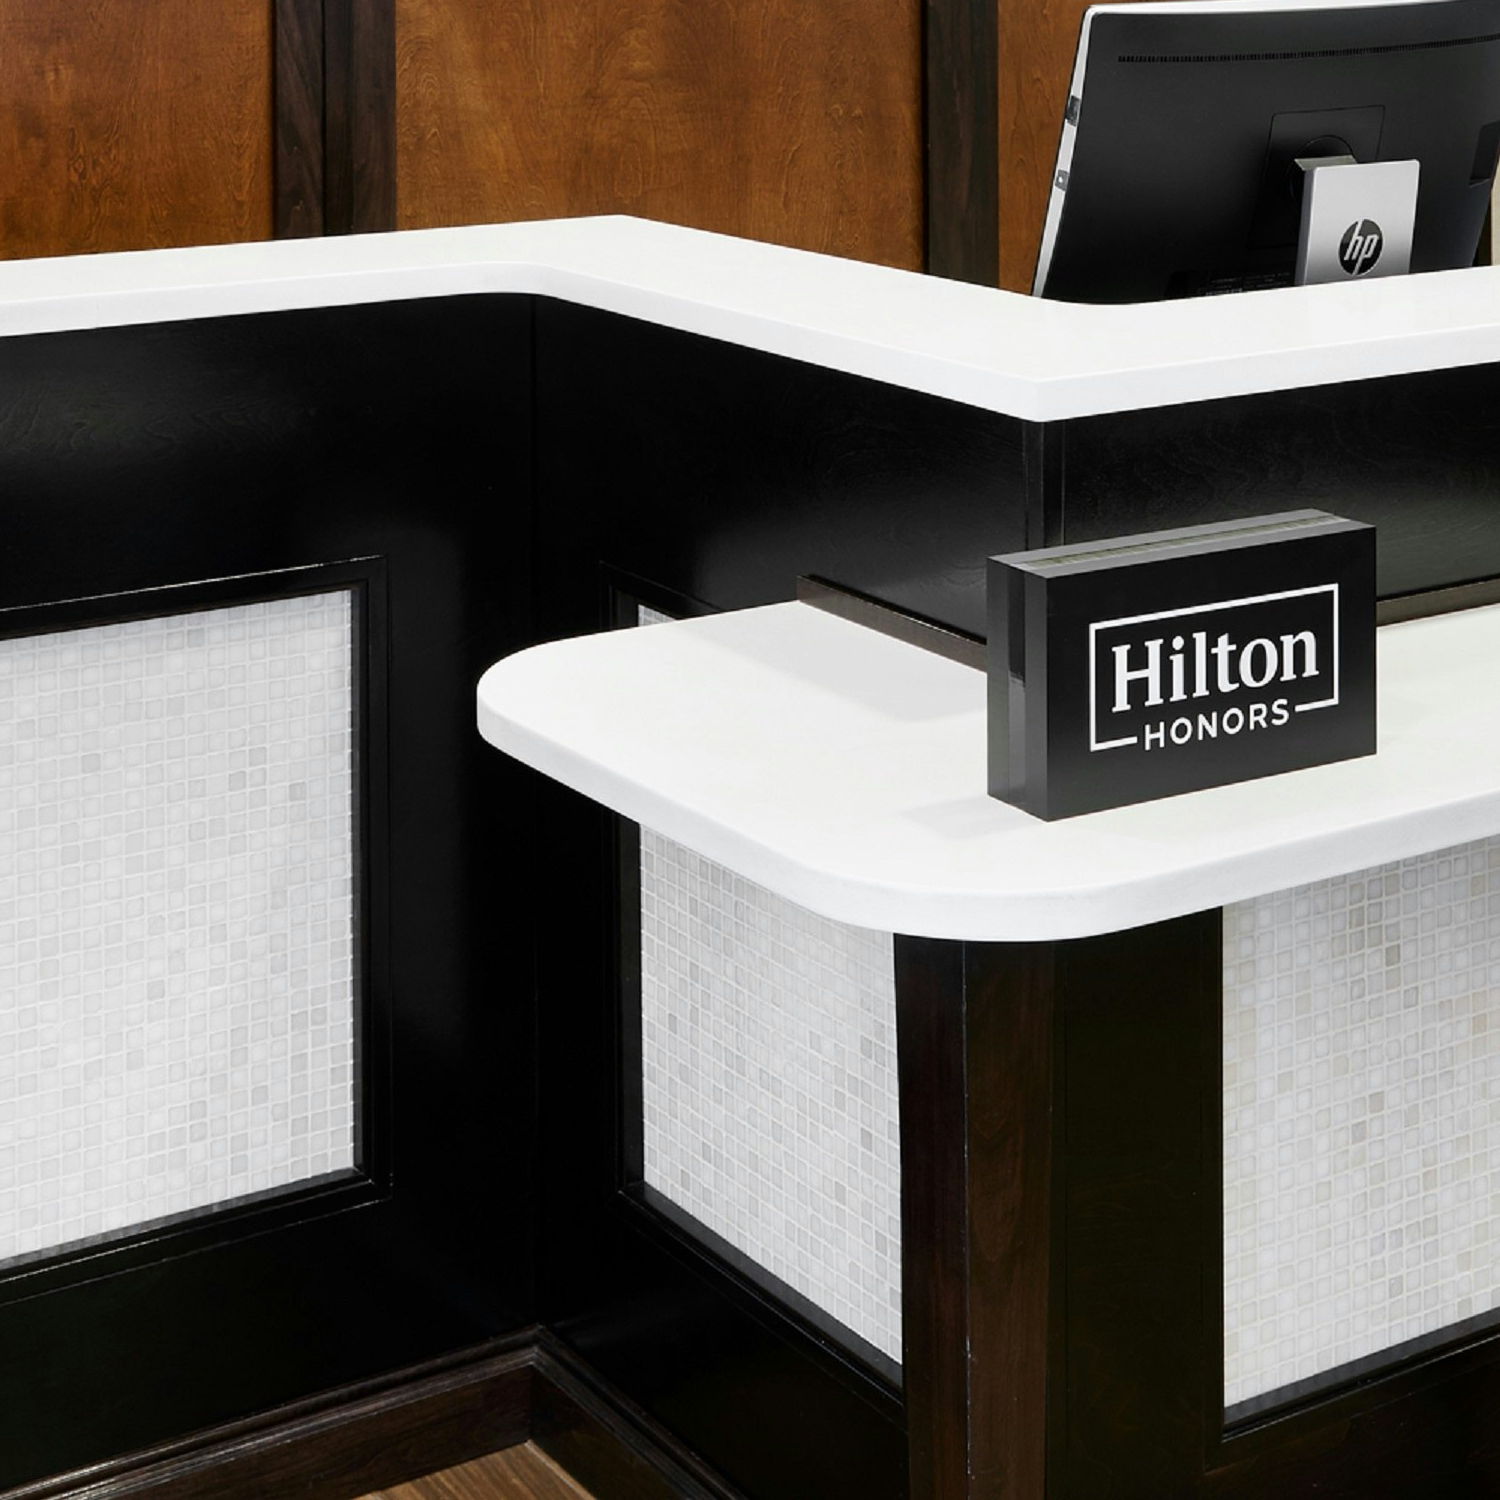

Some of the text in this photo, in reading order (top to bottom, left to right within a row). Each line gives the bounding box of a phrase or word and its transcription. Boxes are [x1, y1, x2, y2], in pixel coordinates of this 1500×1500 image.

[1343, 219, 1380, 276] hp
[1110, 630, 1320, 714] Hilton
[1143, 698, 1290, 752] HONORS
